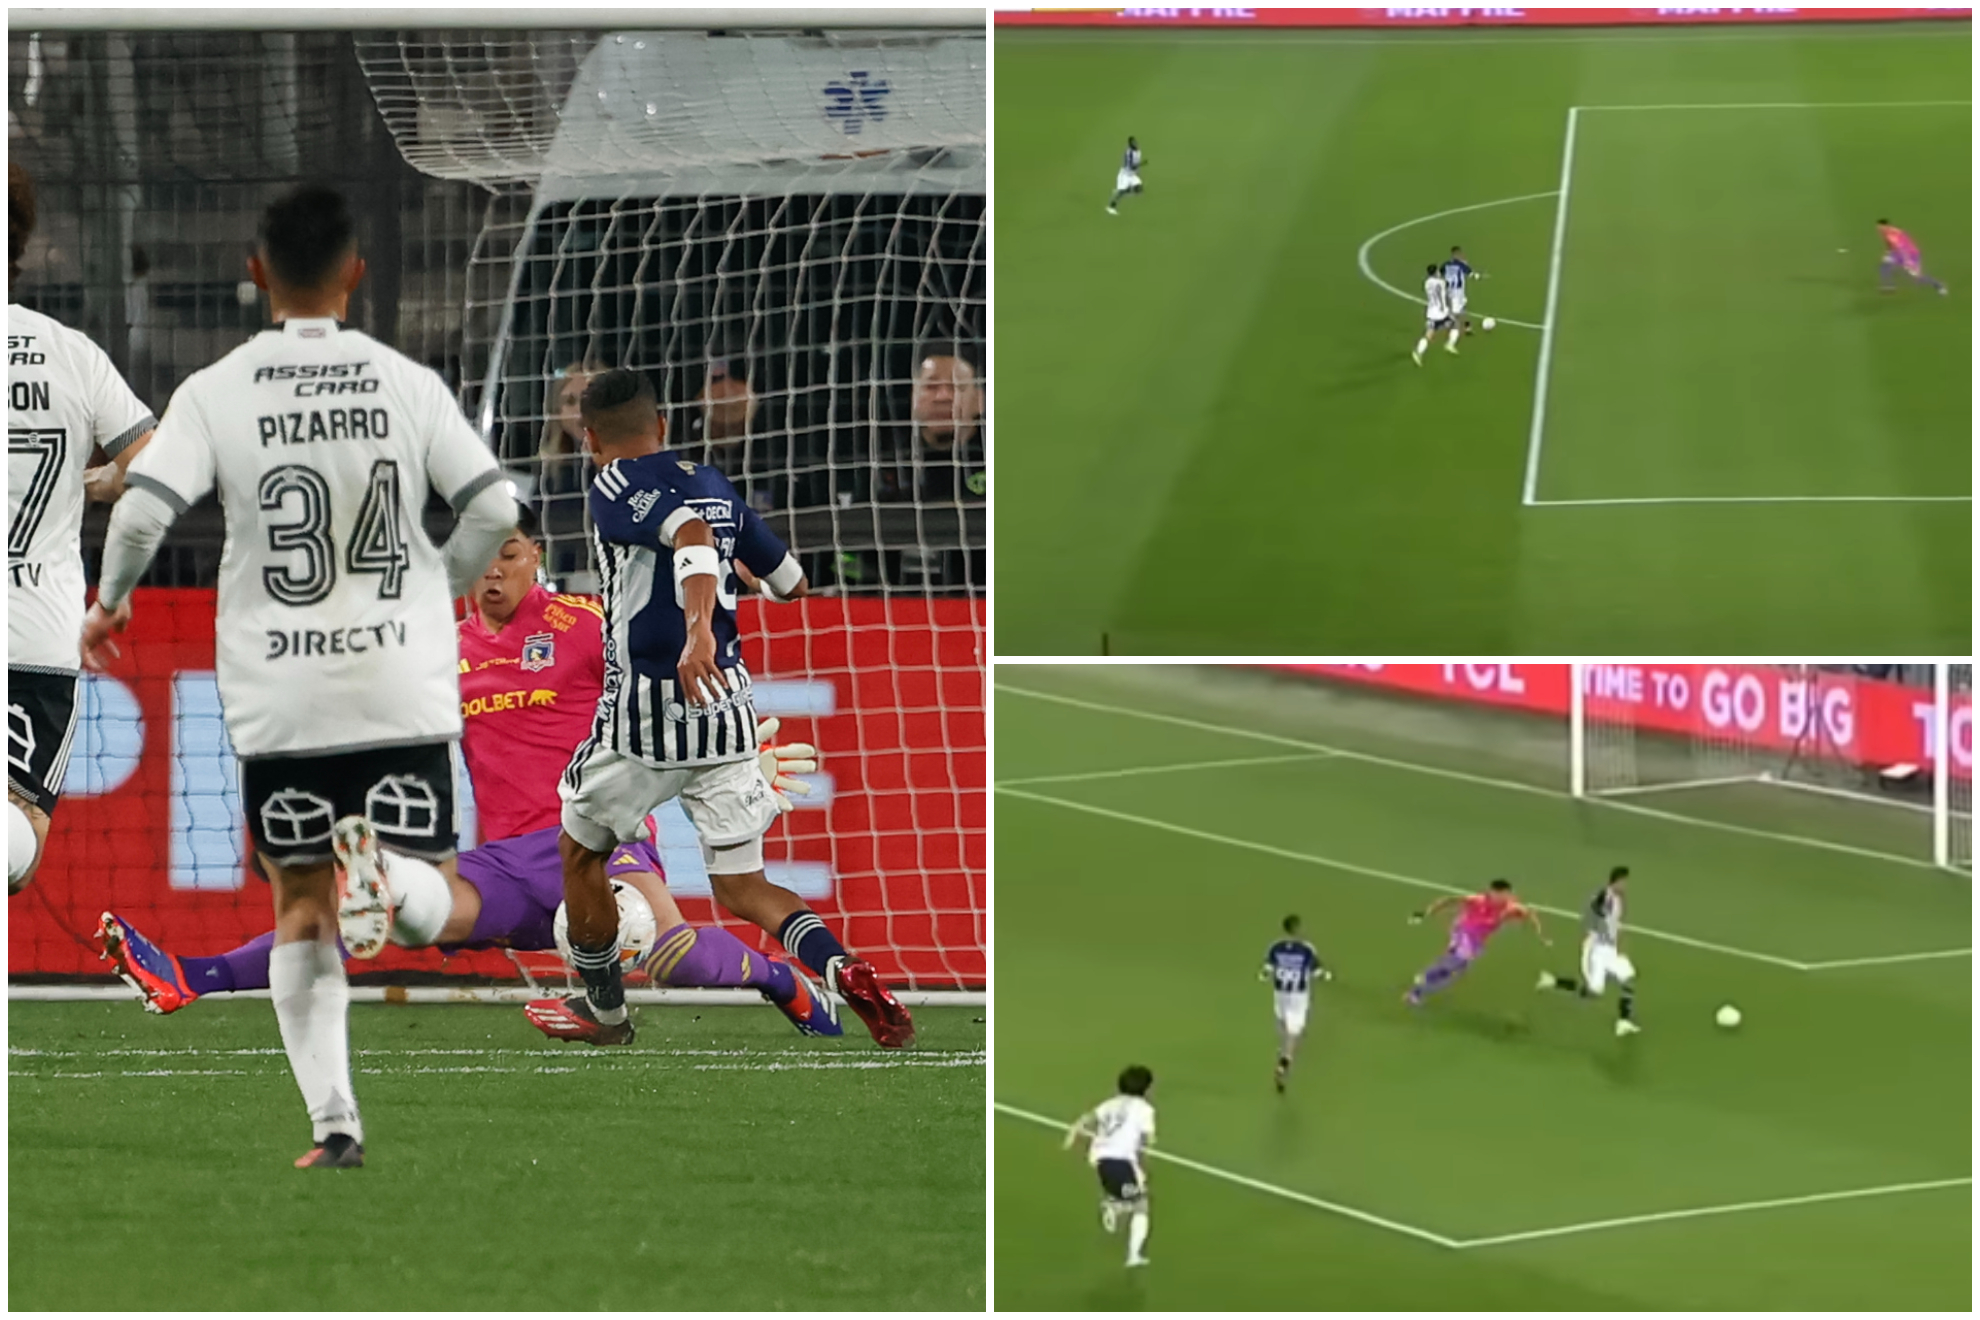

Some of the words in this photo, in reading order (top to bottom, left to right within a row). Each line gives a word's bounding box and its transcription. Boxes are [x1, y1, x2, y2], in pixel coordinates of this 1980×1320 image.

[8, 352, 45, 365] RD
[253, 360, 370, 383] ASSIST
[8, 381, 50, 411] ON
[294, 378, 379, 397] CARD
[258, 407, 389, 448] PIZARRO
[258, 459, 410, 607] 34
[265, 620, 406, 661] DIRECTV
[1652, 671, 1690, 710] TO
[1702, 668, 1765, 732] GO
